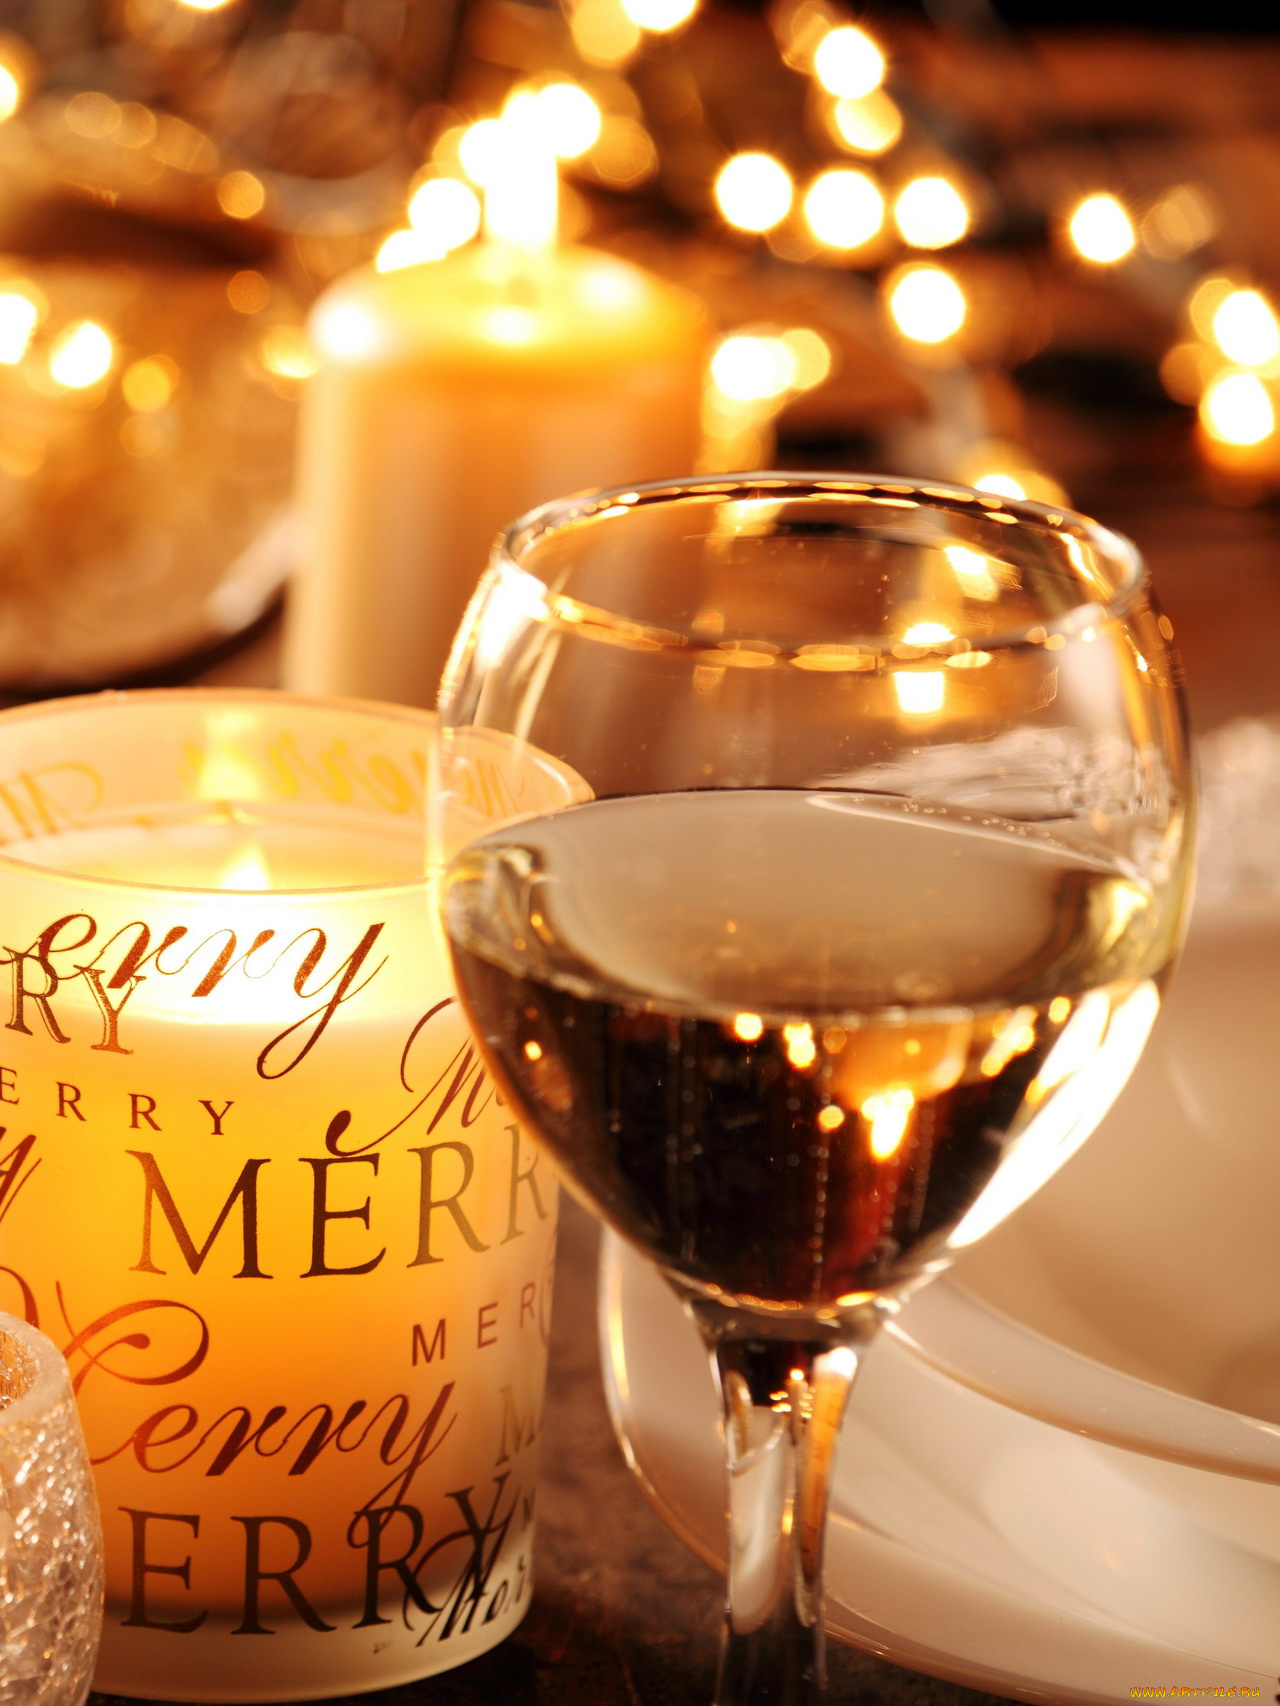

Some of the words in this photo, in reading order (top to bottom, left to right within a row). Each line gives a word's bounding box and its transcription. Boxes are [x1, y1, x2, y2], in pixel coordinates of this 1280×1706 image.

[124, 1120, 549, 1280] MERR
[411, 1281, 536, 1368] MER
[117, 1468, 512, 1636] ERRY
